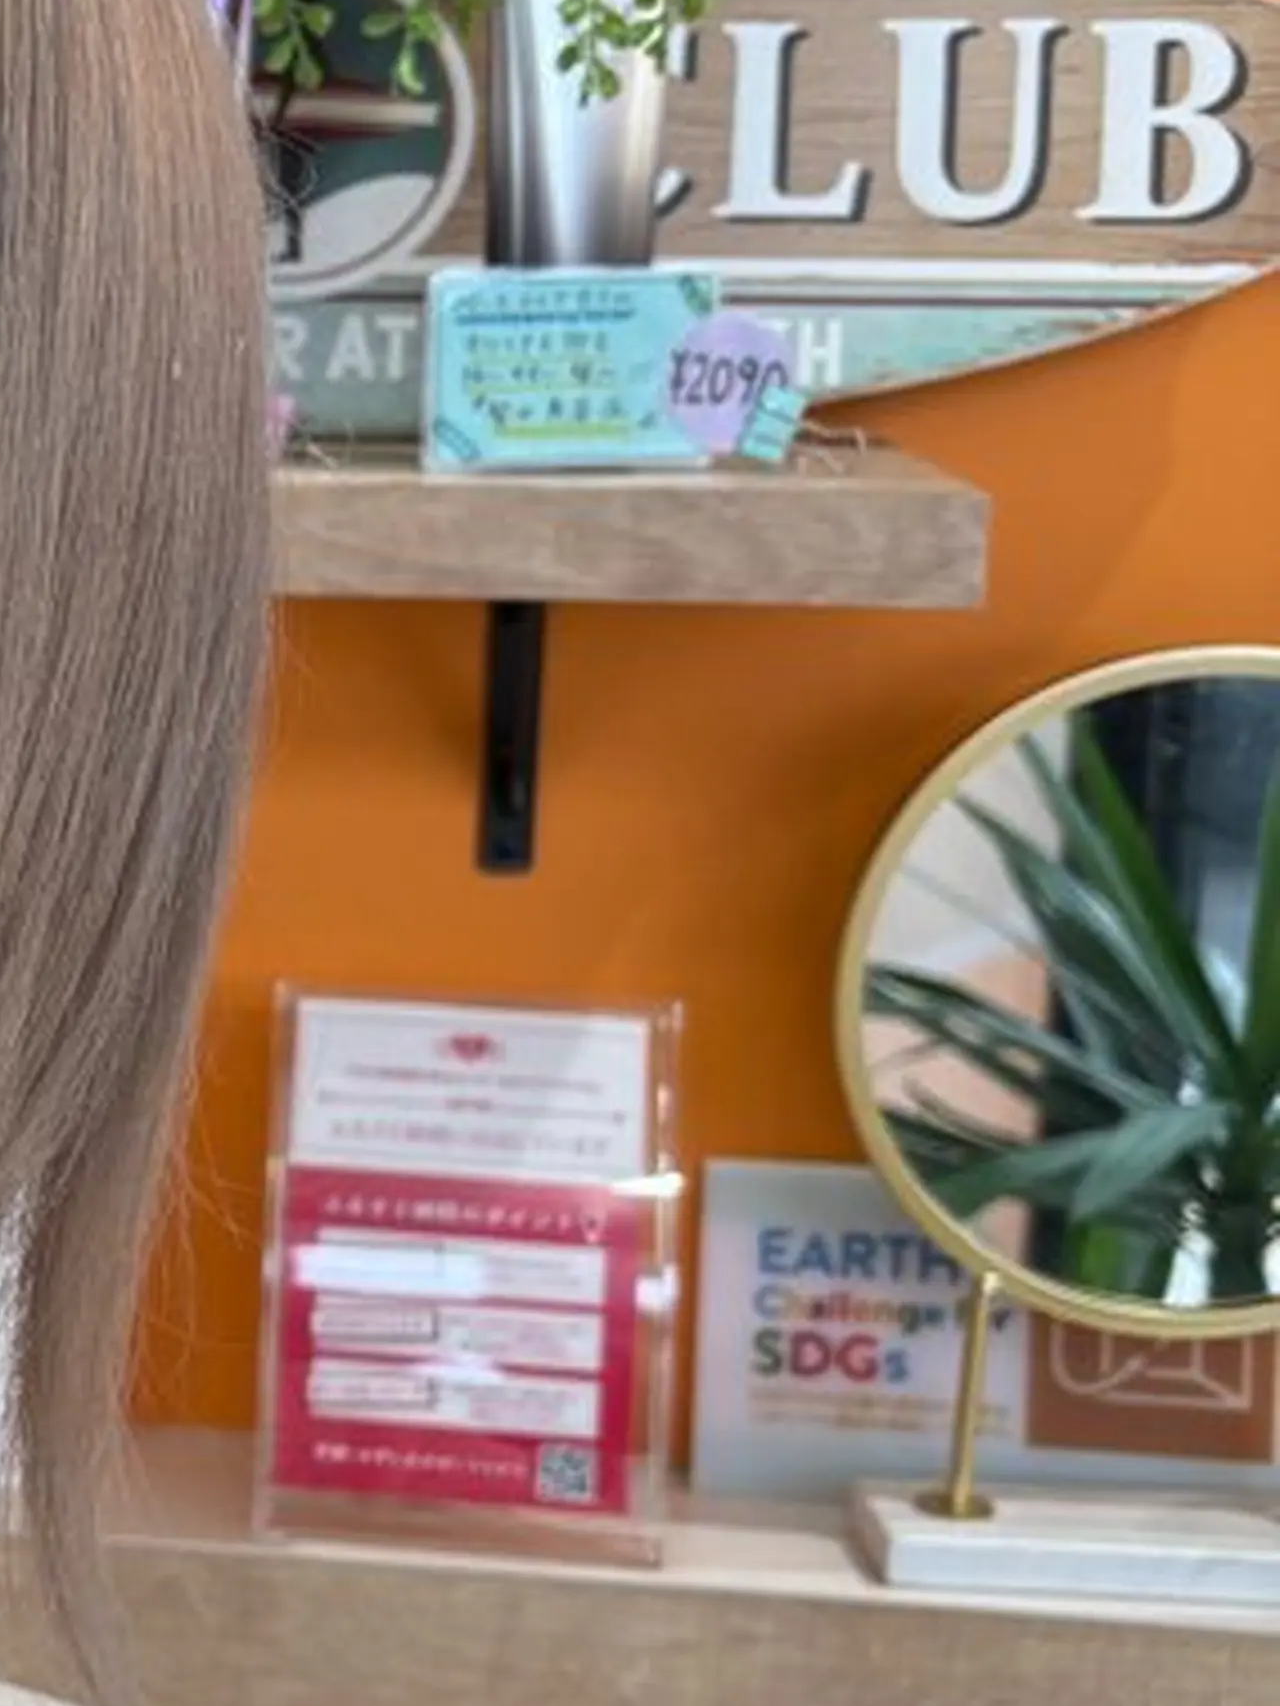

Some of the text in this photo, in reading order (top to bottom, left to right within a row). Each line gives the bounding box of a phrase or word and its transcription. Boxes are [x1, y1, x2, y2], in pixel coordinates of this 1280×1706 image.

[657, 17, 1246, 226] LUB
[757, 1227, 962, 1287] EARTH
[753, 1328, 912, 1385] SDGs
